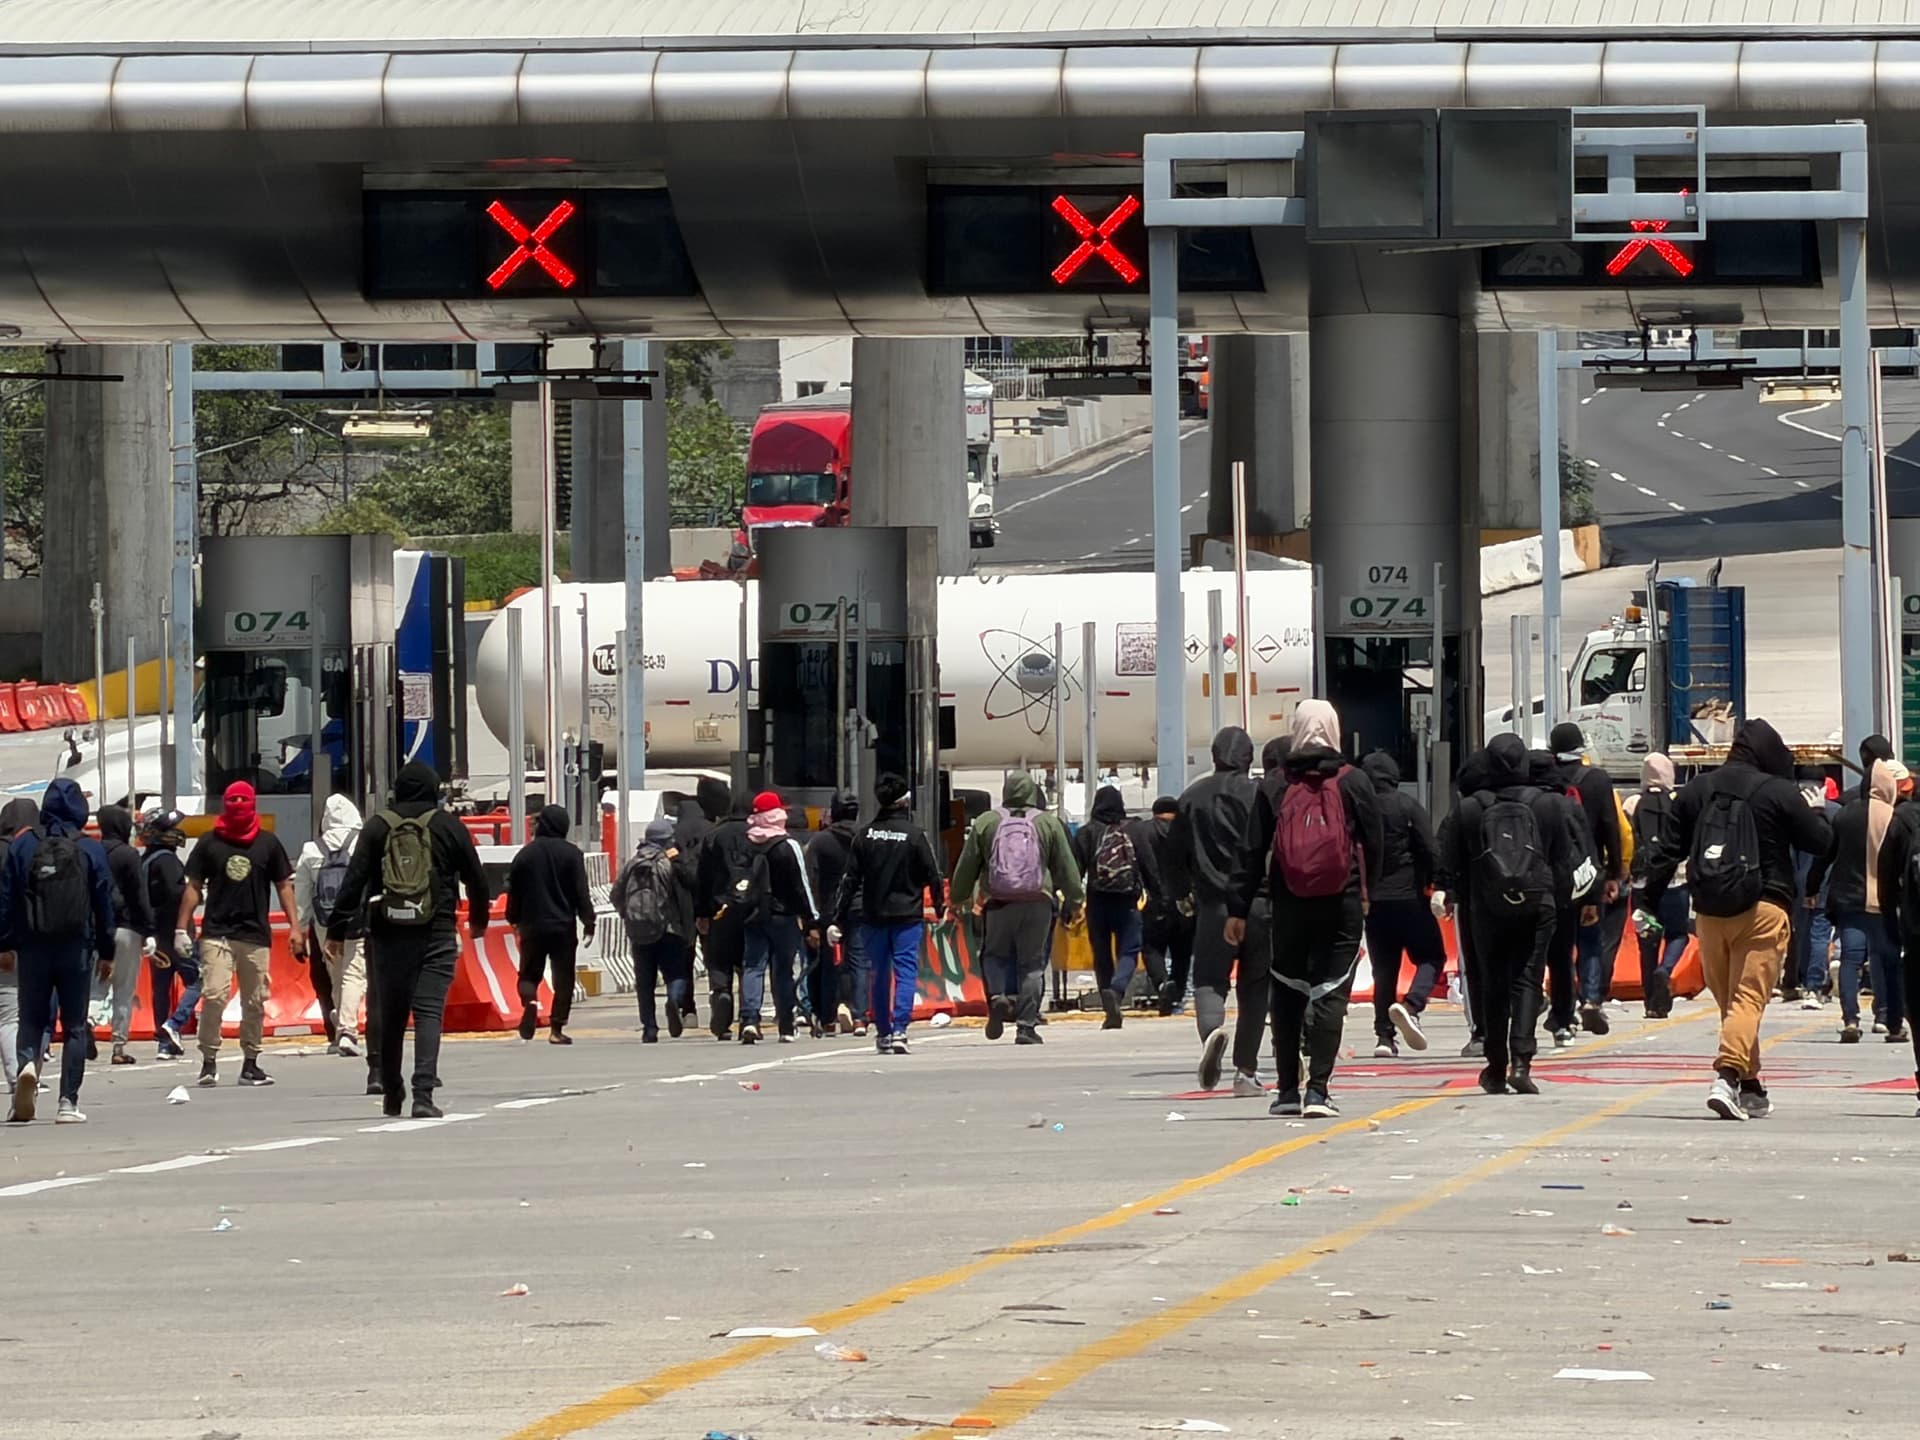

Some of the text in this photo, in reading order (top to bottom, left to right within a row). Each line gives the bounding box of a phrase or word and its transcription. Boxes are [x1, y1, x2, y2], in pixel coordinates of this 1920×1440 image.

[1368, 566, 1408, 584] 074
[1350, 597, 1427, 618] 074
[234, 611, 310, 633] 074
